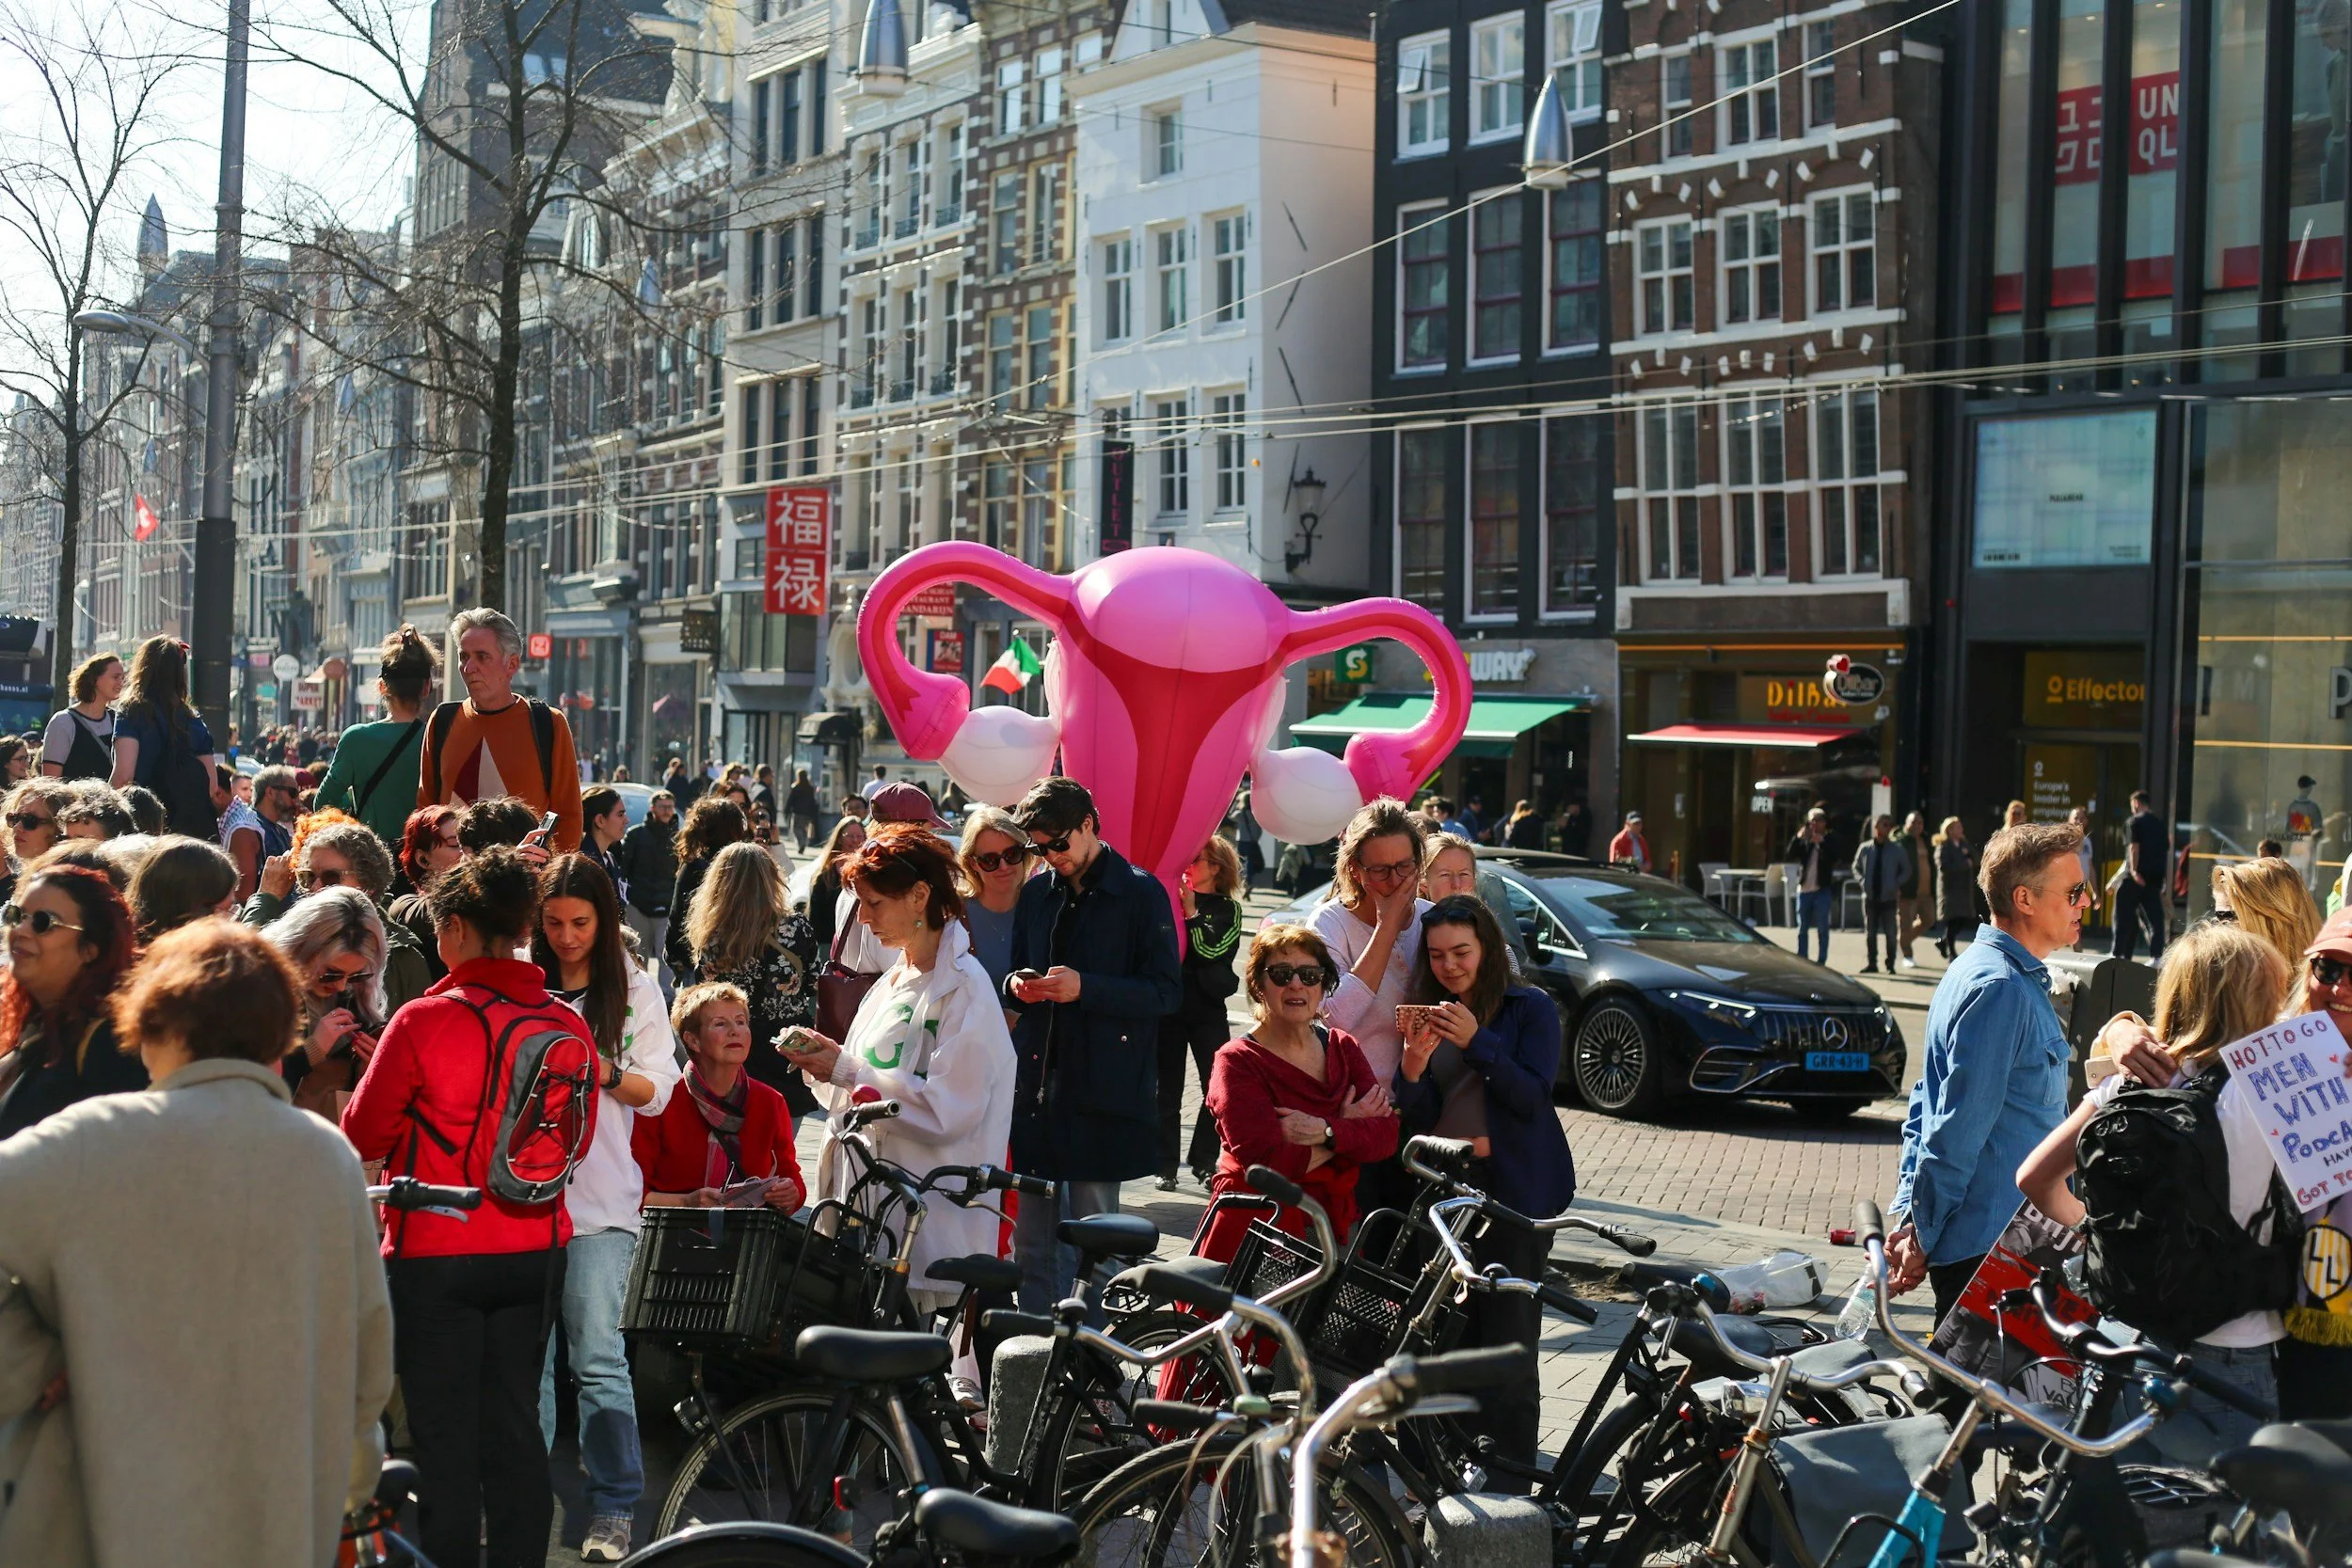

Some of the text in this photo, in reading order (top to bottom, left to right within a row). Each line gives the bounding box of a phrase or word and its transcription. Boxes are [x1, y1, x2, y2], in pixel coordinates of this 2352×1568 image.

[1111, 448, 1125, 537] OUTLET
[1465, 649, 1536, 682] WAY
[1752, 796, 1774, 813] OPEN
[2248, 1052, 2318, 1102] MEN
[2323, 1146, 2352, 1167] HAV
